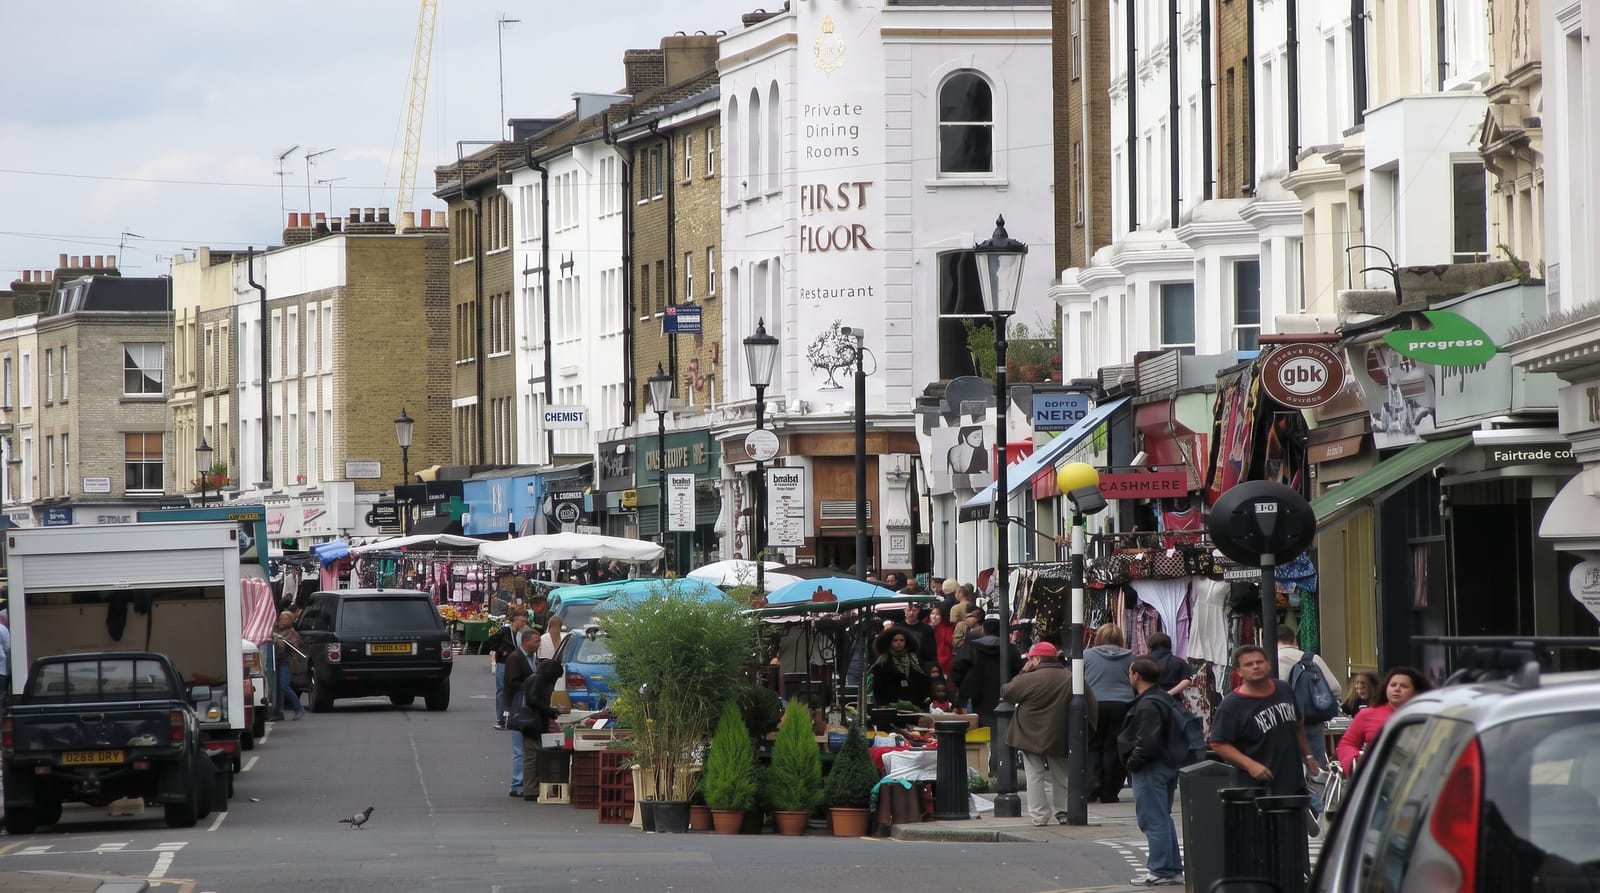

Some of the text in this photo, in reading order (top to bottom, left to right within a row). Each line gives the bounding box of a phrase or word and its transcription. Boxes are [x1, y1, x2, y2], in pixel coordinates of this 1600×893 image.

[804, 102, 863, 118] Private
[806, 123, 860, 140] Dining
[806, 144, 859, 159] Rooms
[801, 181, 873, 212] FIRST
[800, 223, 875, 253] FLOOR
[800, 285, 874, 300] Restaurant
[1409, 339, 1483, 351] progreso
[1283, 365, 1322, 386] gbk
[545, 412, 583, 422] CHEMIST
[1494, 449, 1552, 461] Fairtrade
[1100, 480, 1181, 492] CASHMERE
[1254, 706, 1277, 734] NEW
[98, 751, 120, 761] DRY
